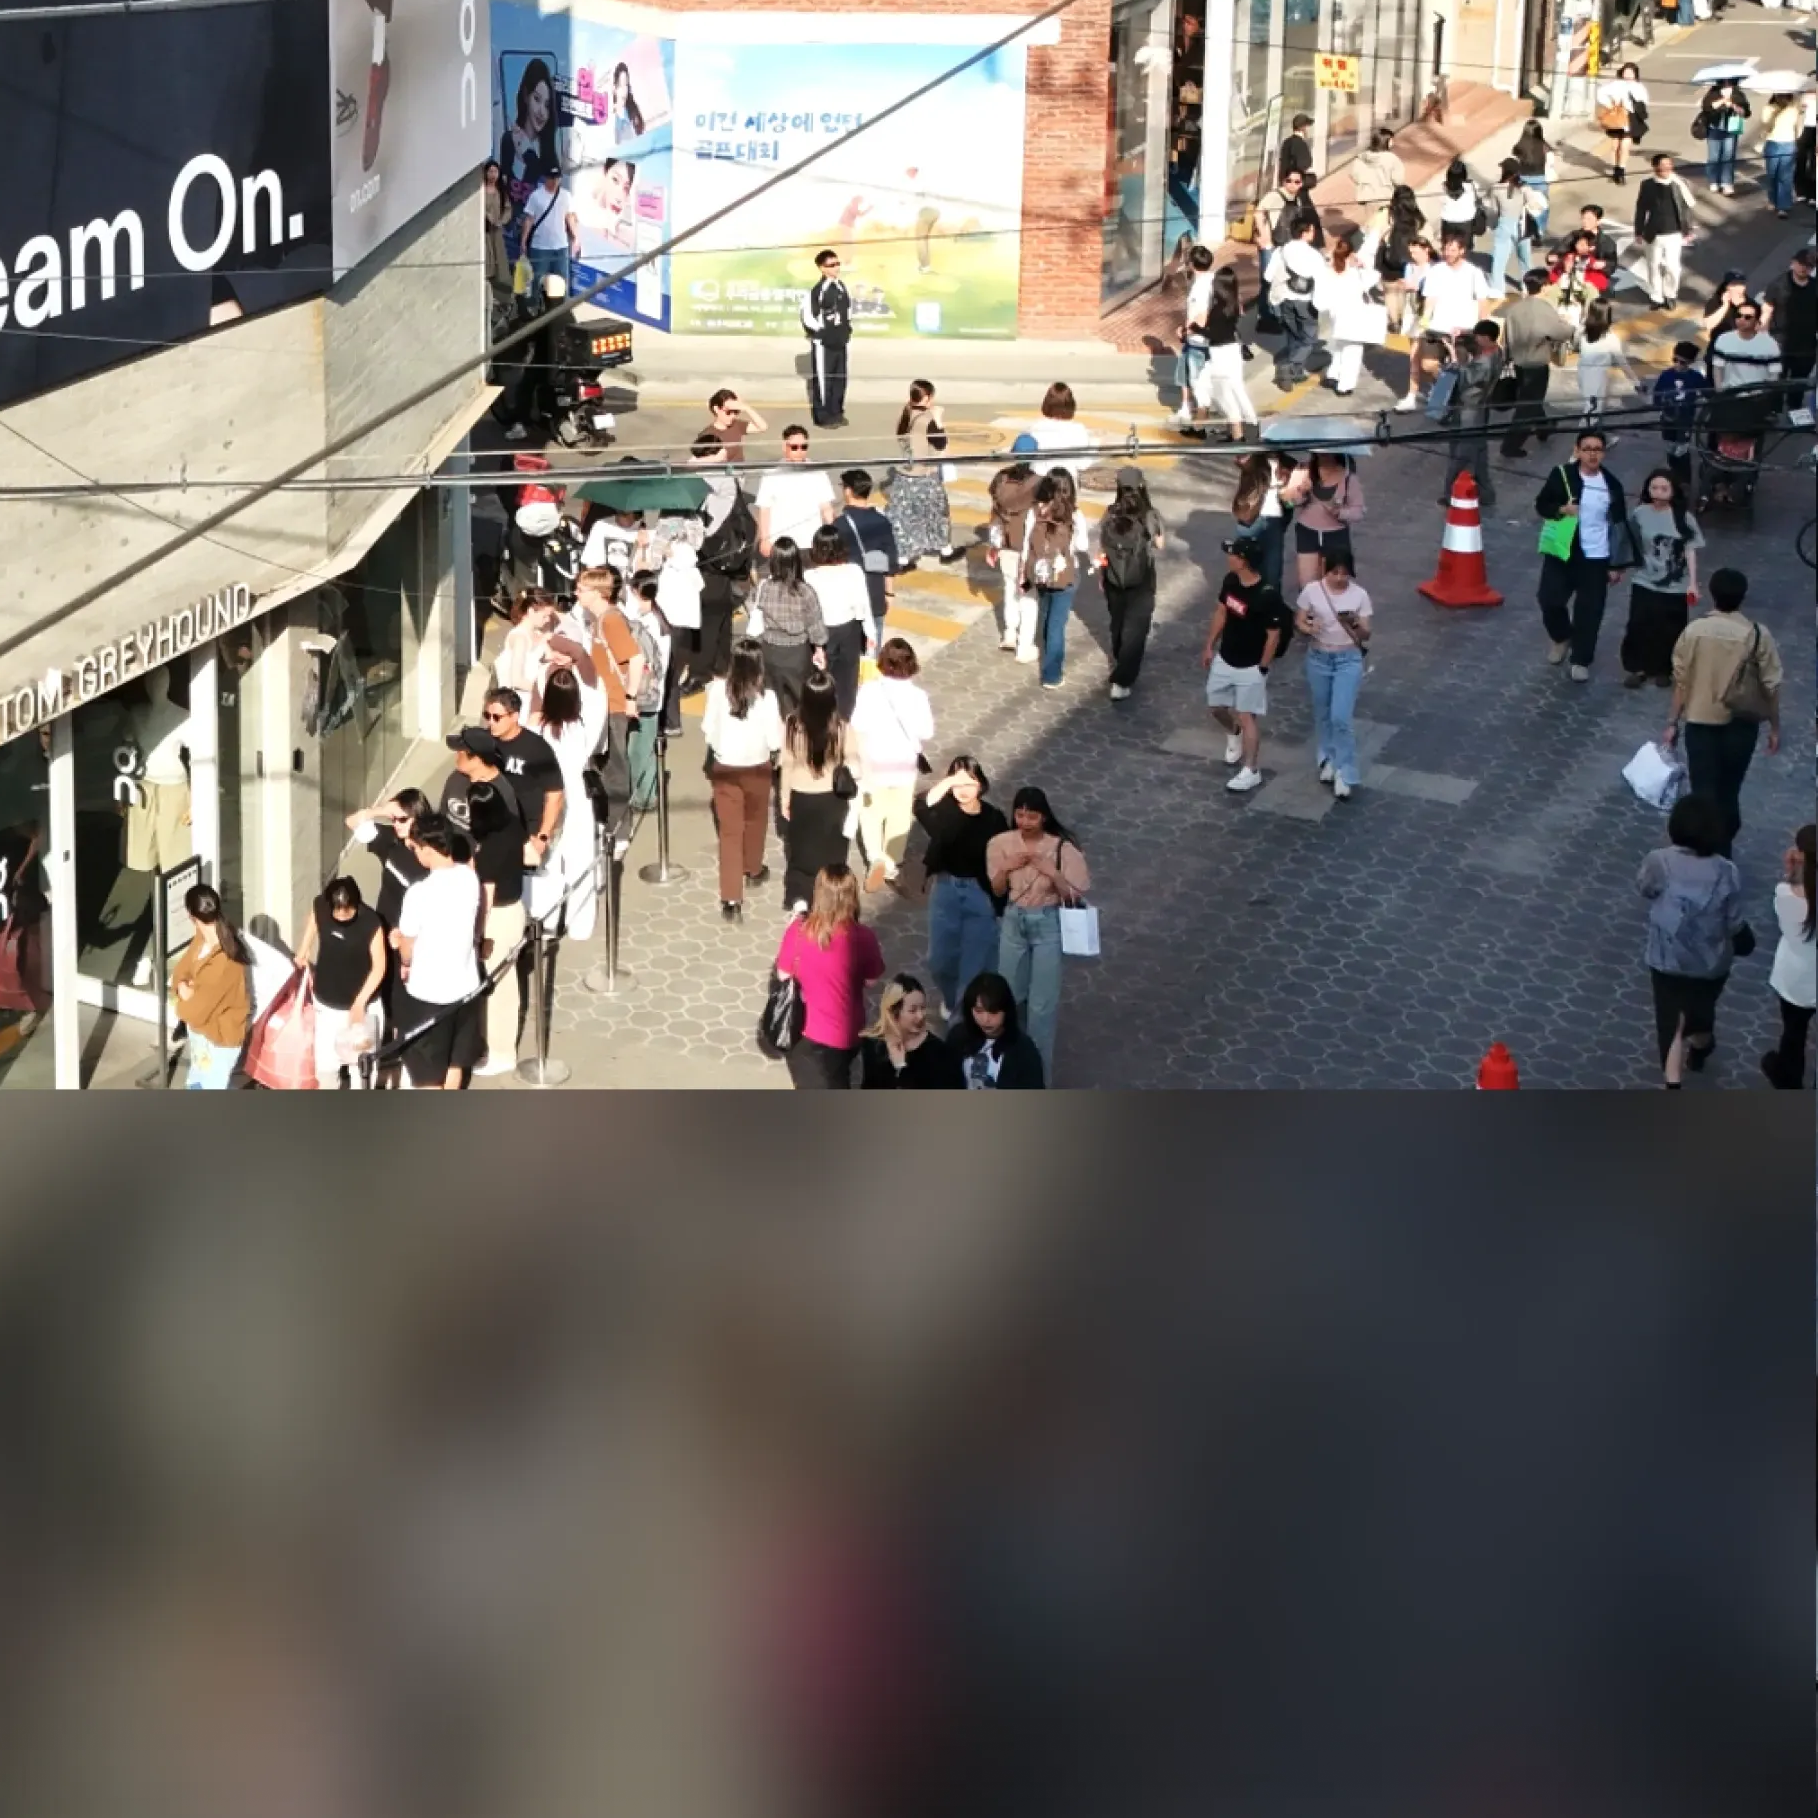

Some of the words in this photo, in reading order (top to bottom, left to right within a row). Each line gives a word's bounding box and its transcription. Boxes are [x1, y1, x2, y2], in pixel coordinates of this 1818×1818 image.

[695, 111, 738, 132] 이건
[744, 111, 814, 134] 세상에
[168, 153, 305, 272] On.
[75, 582, 251, 700] GREYHOUND
